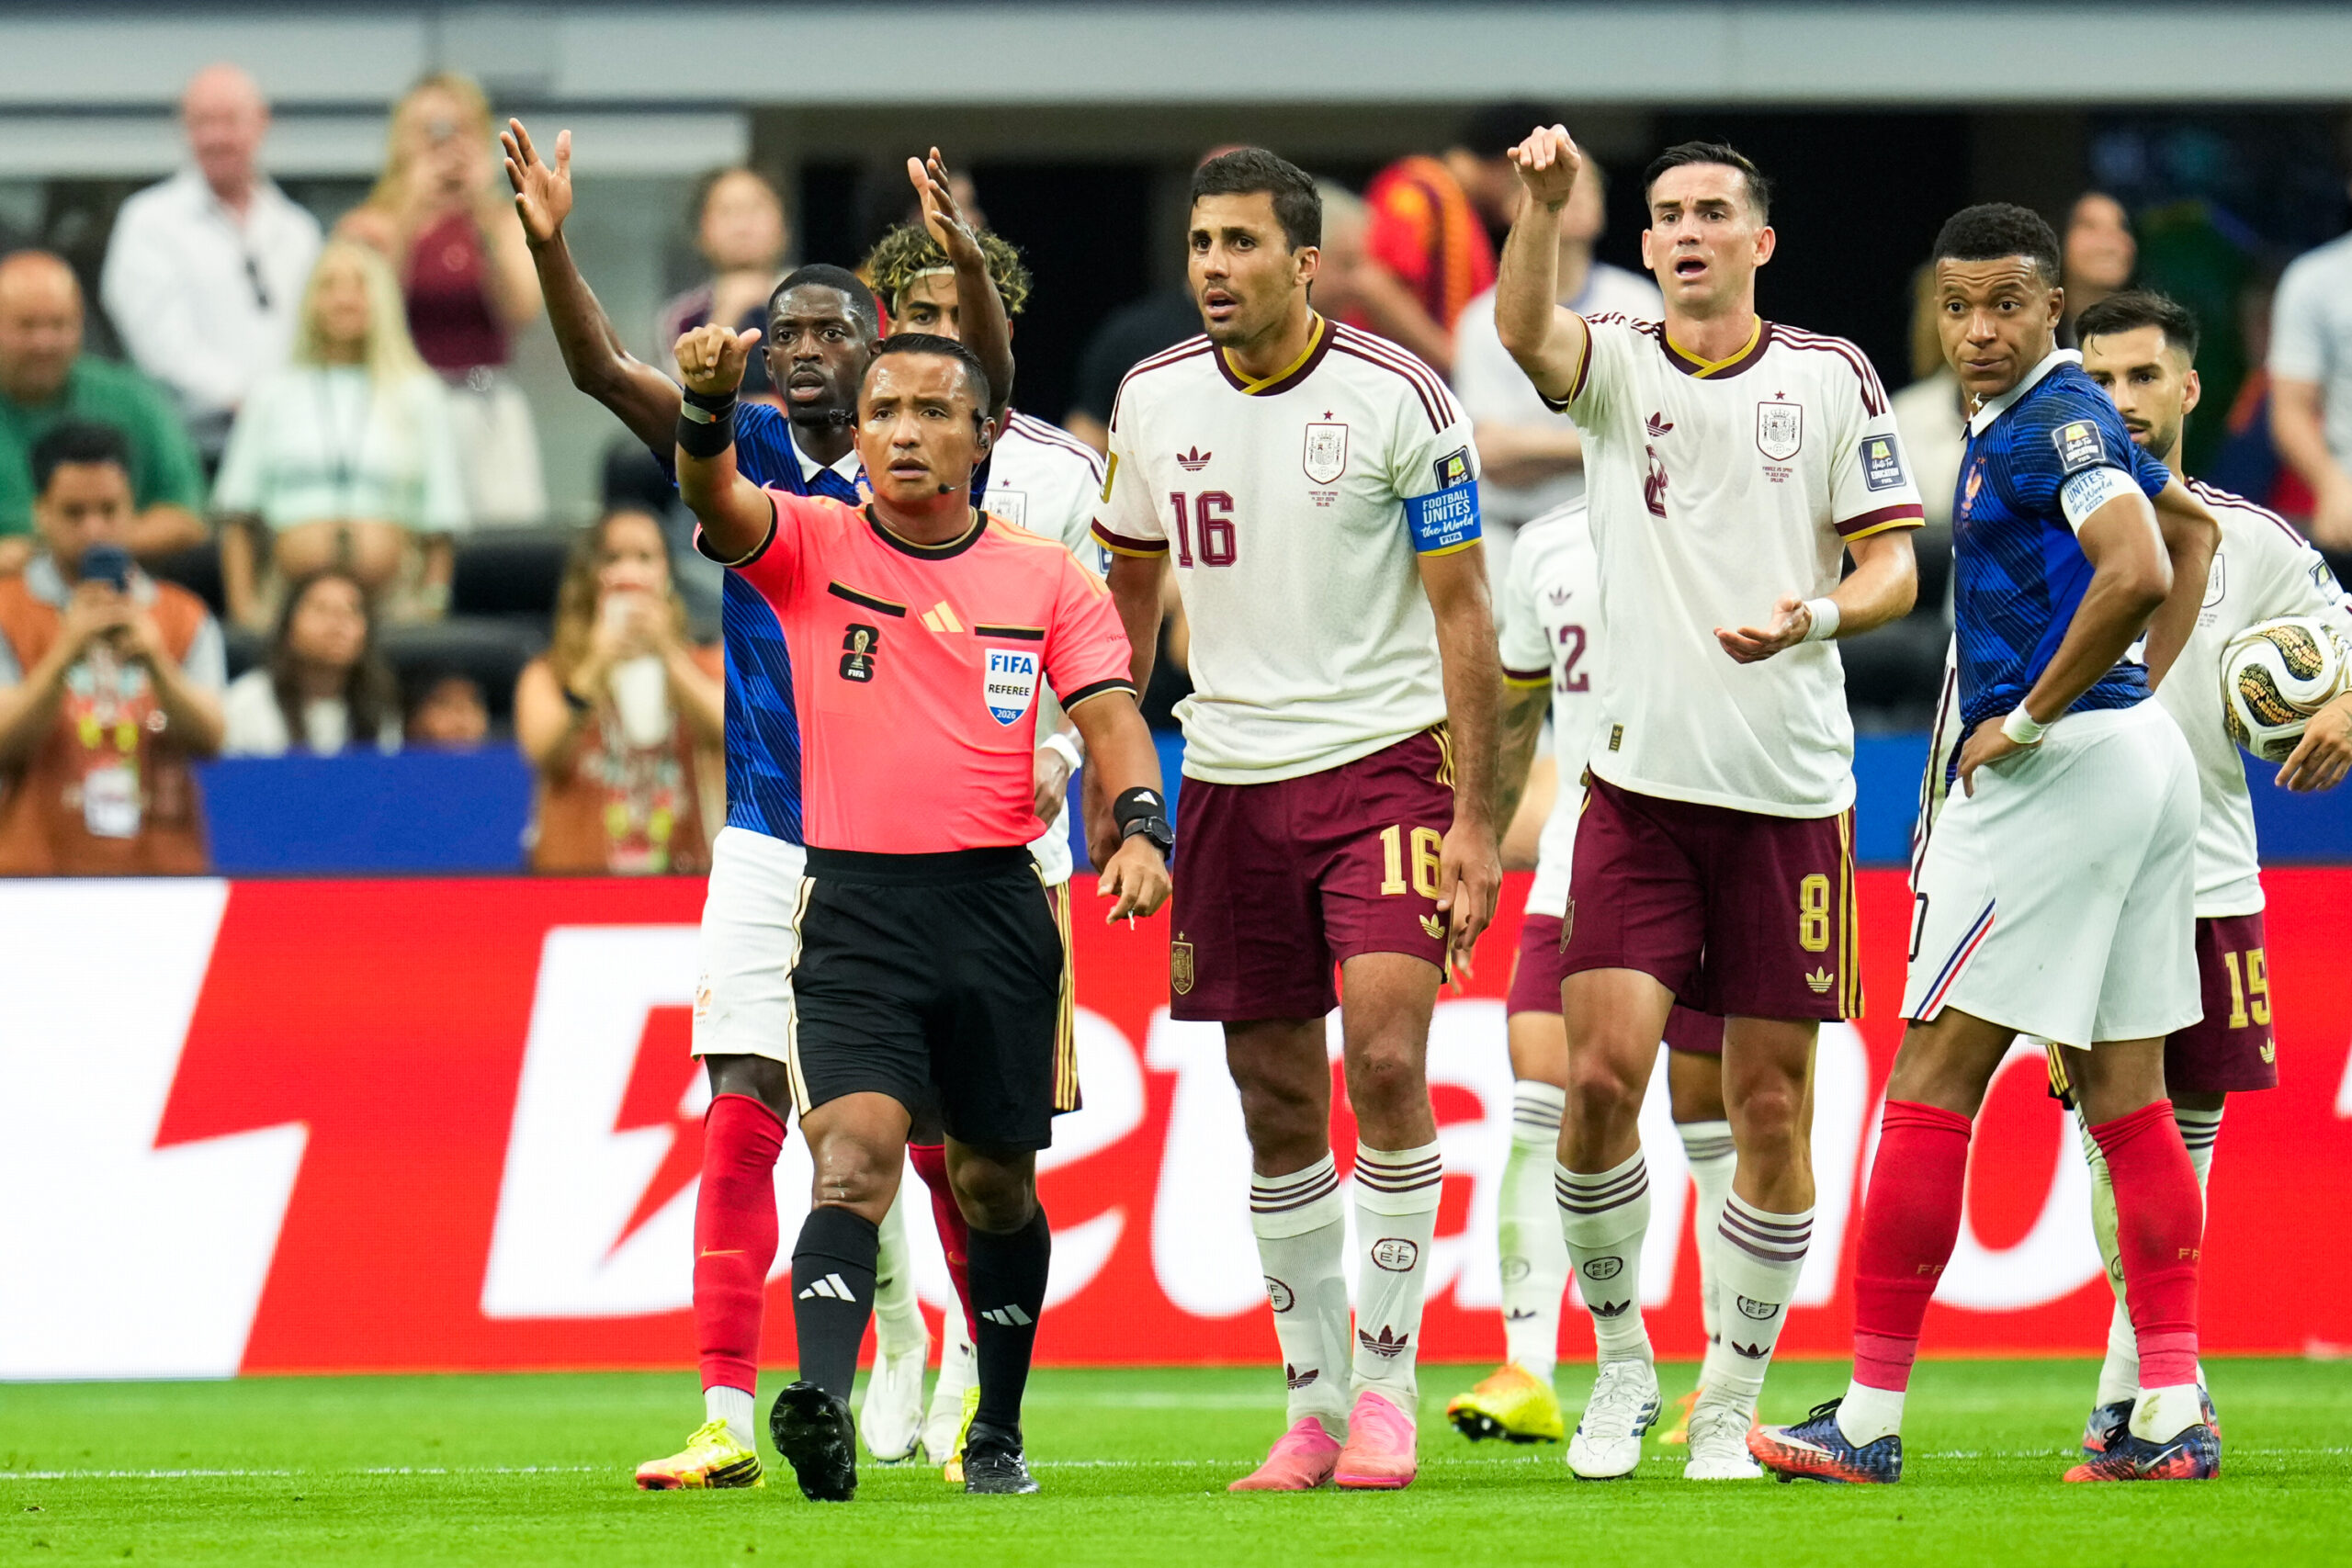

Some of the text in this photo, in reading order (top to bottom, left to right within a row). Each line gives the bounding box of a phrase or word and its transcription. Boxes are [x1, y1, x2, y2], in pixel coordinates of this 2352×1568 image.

[2066, 470, 2106, 503] UNITES
[1422, 489, 1470, 511] FOOTBALL
[1422, 499, 1471, 525] UNITES
[1170, 491, 1238, 569] 16
[1420, 513, 1474, 538] the World
[1440, 532, 1463, 545] FIFA
[847, 669, 865, 678] FIFA
[991, 654, 1033, 675] FIFA
[989, 683, 1030, 696] REFEREE
[2243, 678, 2295, 718] NEW YORK
[997, 709, 1016, 719] 2026
[1380, 824, 1442, 899] 16
[1799, 874, 1830, 952] 8
[2224, 947, 2271, 1029] 15
